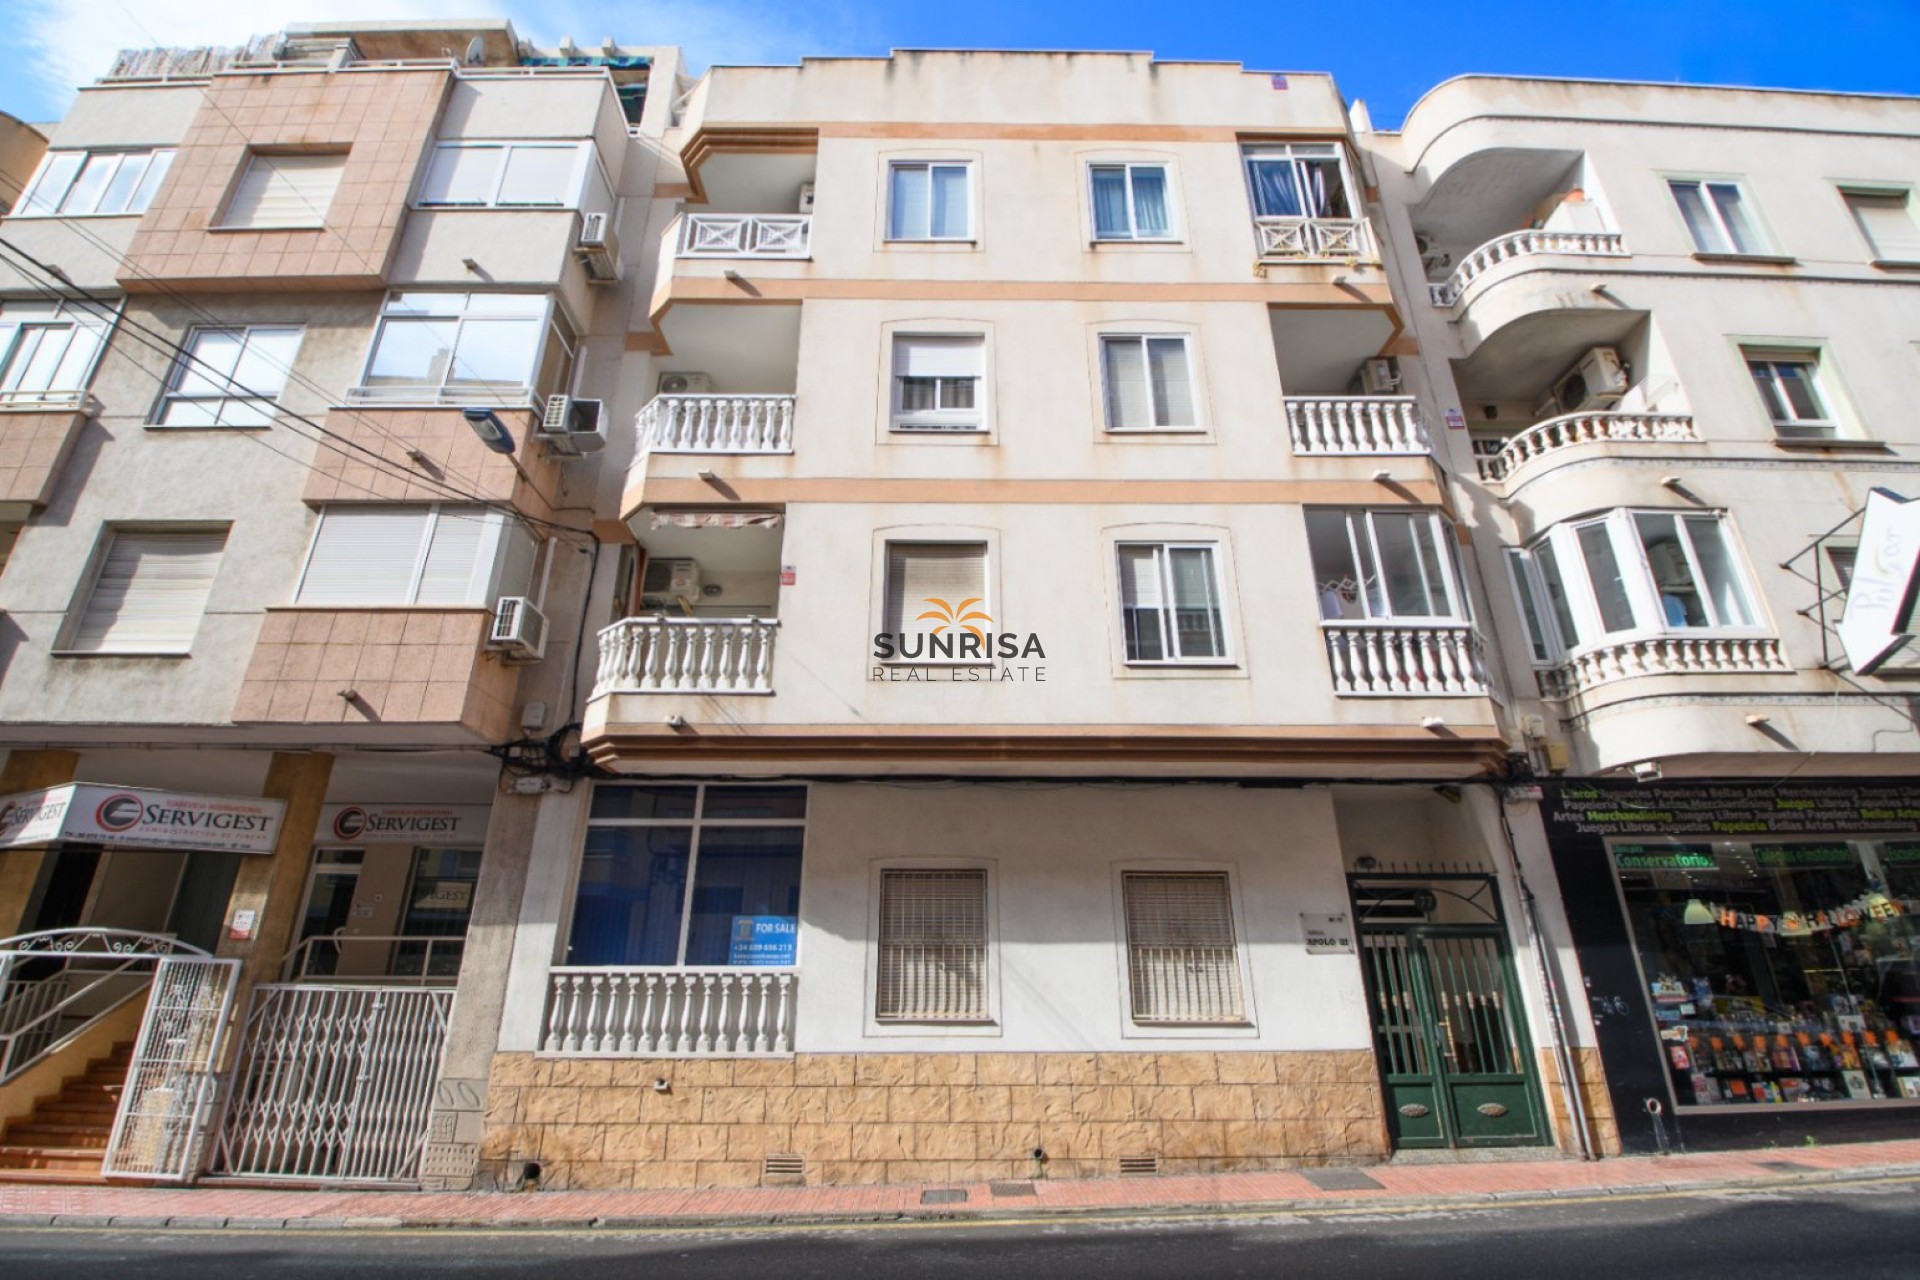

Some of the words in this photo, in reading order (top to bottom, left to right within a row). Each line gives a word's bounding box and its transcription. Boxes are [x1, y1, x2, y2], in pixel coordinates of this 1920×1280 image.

[142, 803, 274, 832] SERVIGEST
[365, 813, 463, 832] SERVIGEST
[1553, 811, 1585, 822] Artes
[1586, 810, 1674, 823] Merchandising
[1675, 811, 1714, 823] Juegos
[1716, 810, 1752, 820] Libros
[1576, 822, 1617, 834] Juegos
[1620, 822, 1657, 832] Libros
[1659, 821, 1711, 833] Juguetes
[755, 923, 774, 934] FOR
[775, 923, 796, 934] SALE
